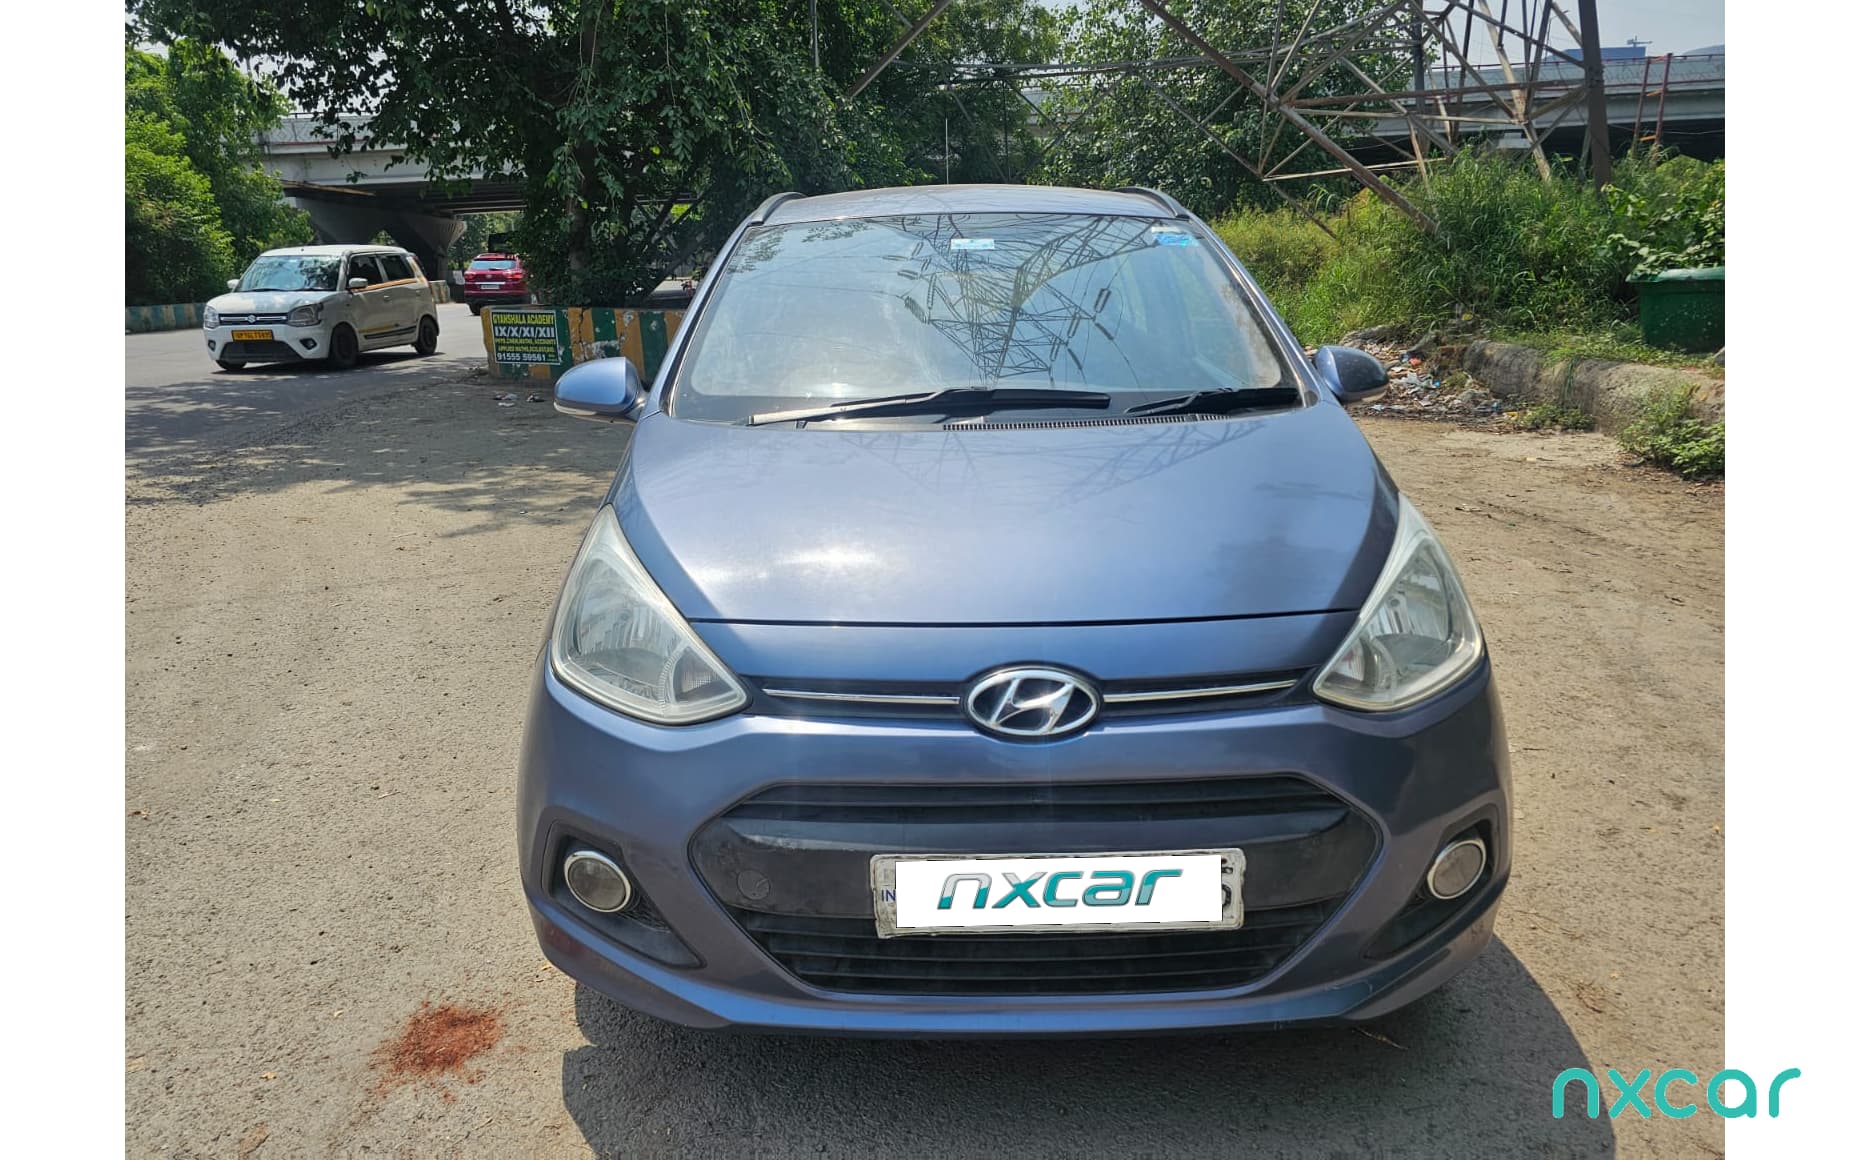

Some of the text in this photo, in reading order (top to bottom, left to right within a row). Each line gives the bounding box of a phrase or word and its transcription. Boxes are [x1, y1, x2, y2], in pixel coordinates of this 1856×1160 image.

[493, 314, 554, 325] GYANSHALA ACADEMY
[494, 326, 555, 337] IX/X/XI/XII
[497, 352, 521, 361] 91555
[881, 889, 896, 902] IN
